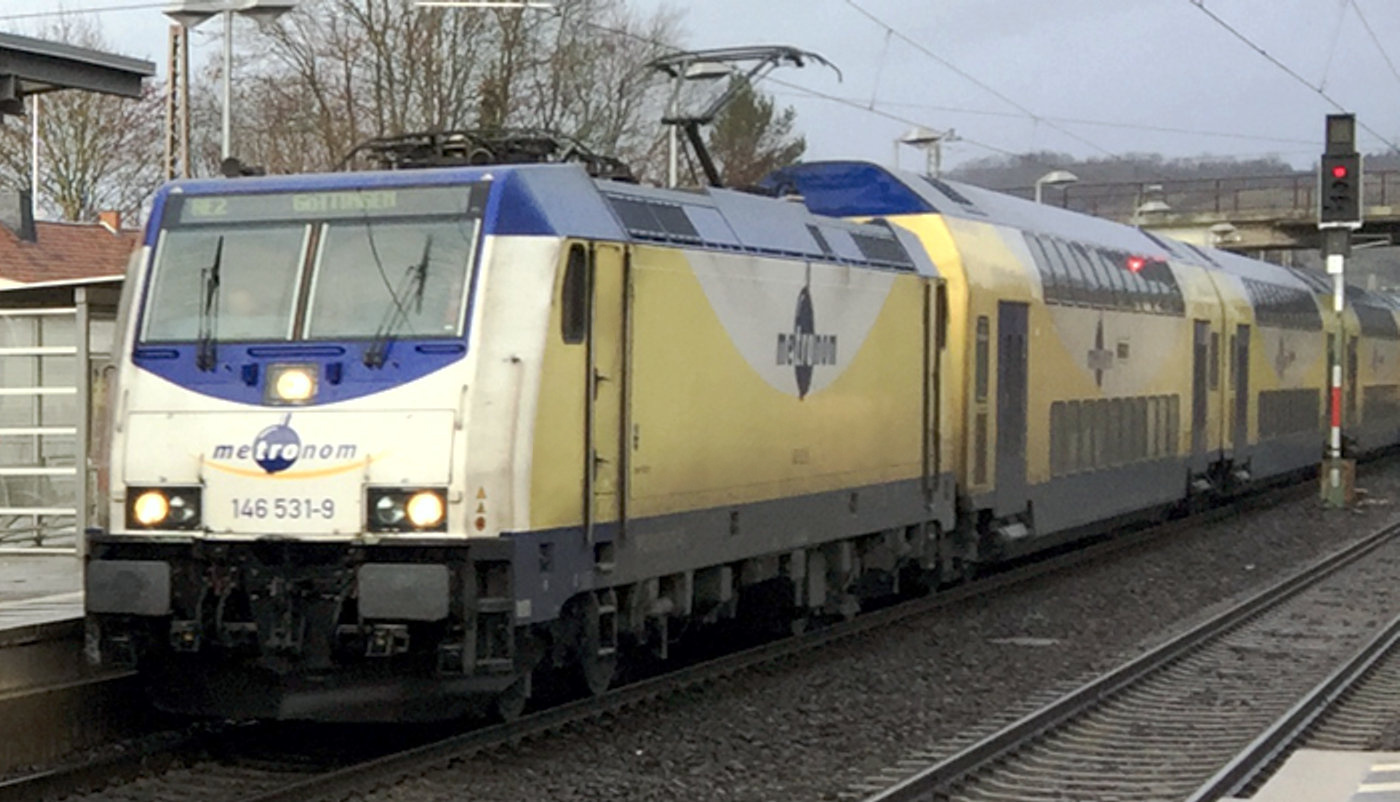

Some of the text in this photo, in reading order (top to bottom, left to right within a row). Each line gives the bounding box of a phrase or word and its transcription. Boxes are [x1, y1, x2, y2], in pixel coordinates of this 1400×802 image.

[212, 441, 358, 461] metronom
[232, 498, 335, 519] 146 531-9
